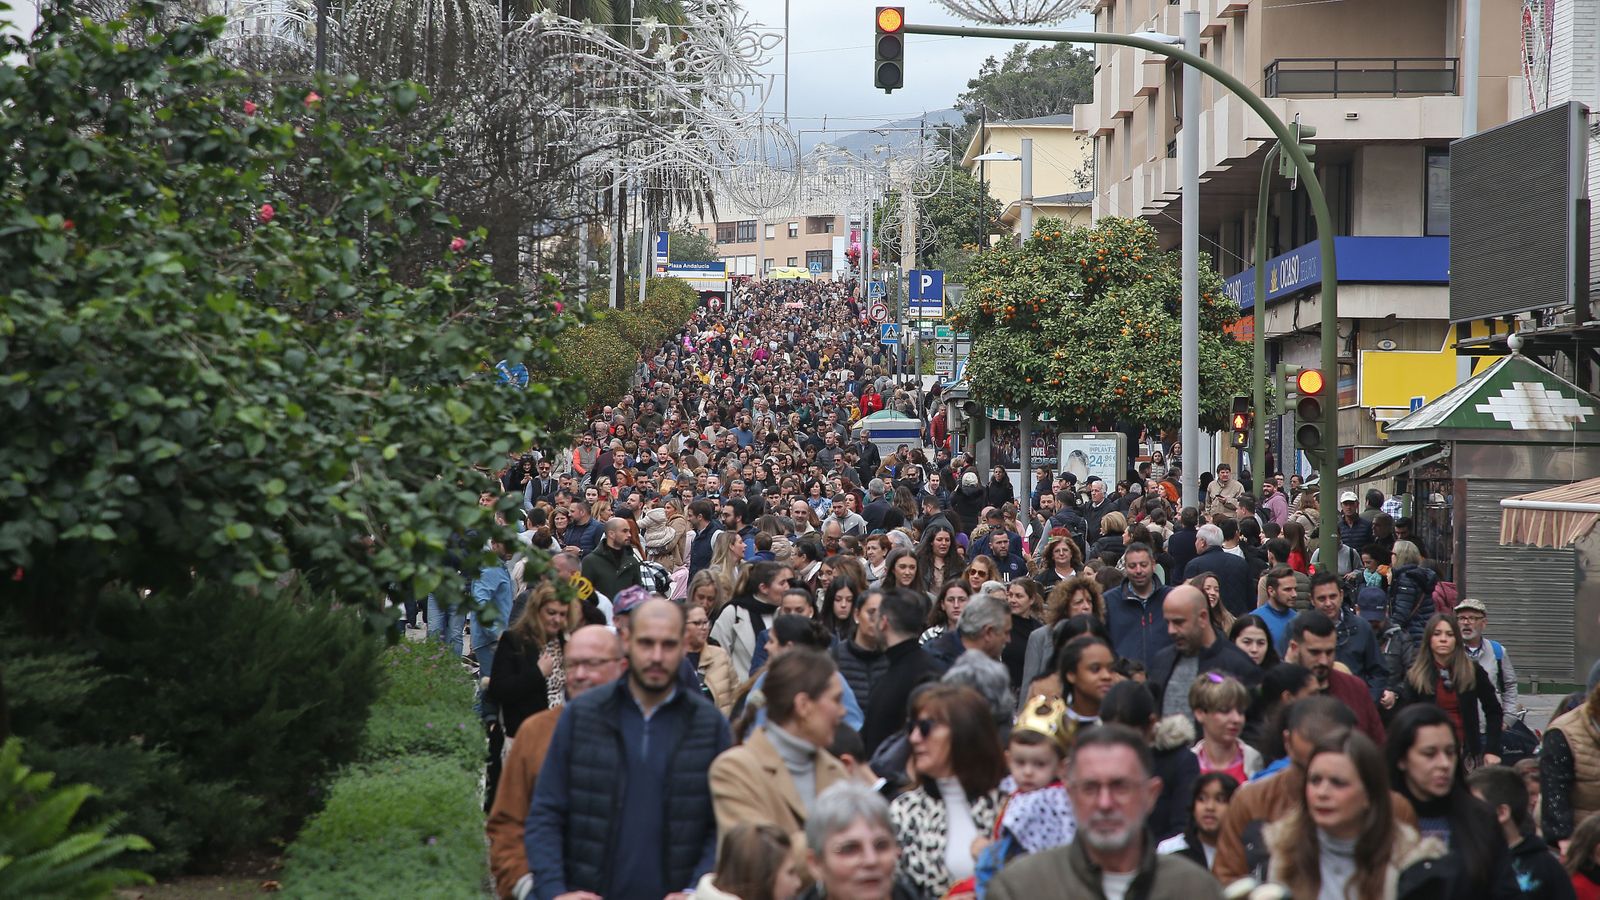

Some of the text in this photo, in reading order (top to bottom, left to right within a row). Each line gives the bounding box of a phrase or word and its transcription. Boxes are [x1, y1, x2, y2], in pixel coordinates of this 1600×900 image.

[1280, 255, 1299, 288] OCASO
[921, 275, 933, 294] P
[1238, 433, 1244, 444] 2
